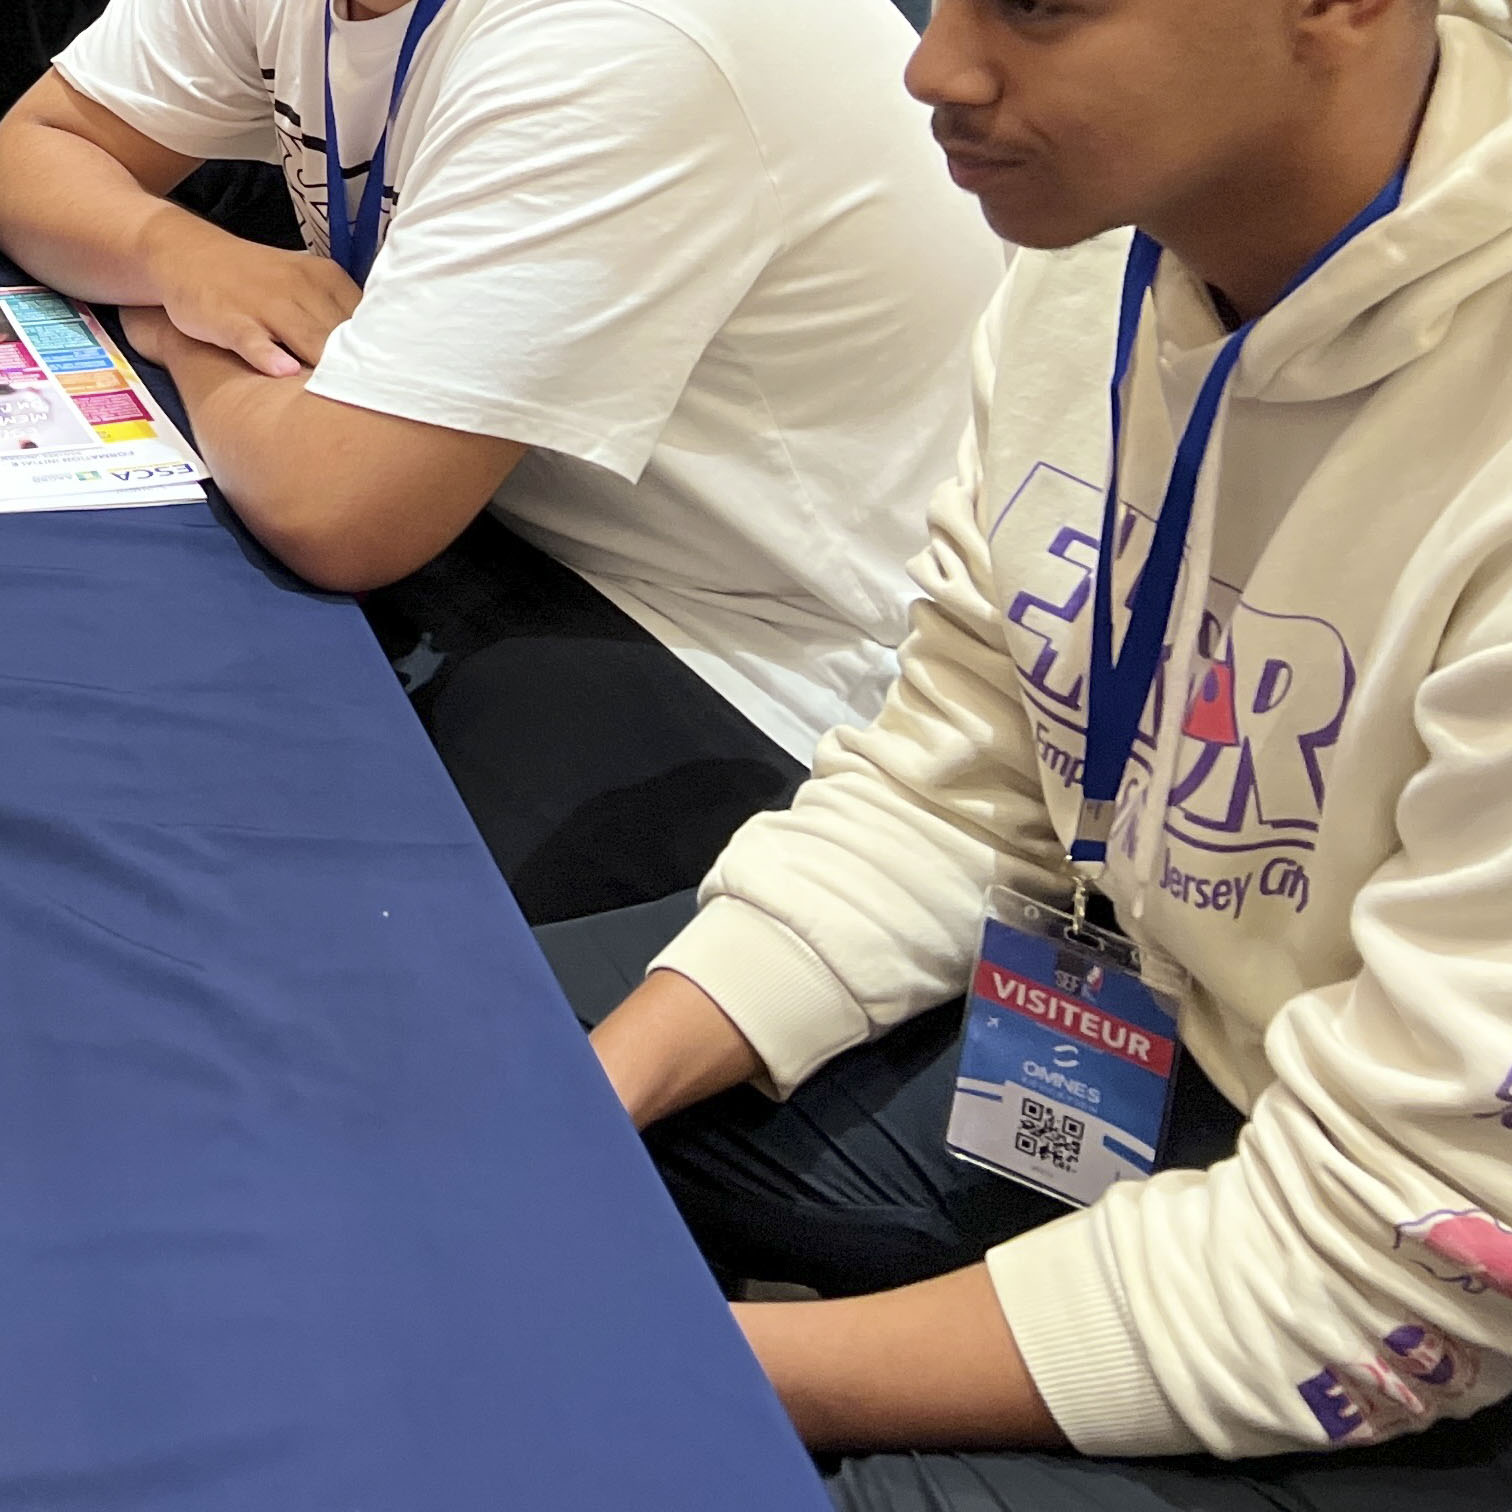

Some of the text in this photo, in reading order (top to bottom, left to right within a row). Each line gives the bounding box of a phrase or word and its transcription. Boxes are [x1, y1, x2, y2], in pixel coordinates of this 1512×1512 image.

[107, 463, 195, 486] ESCA
[1159, 847, 1254, 920] Jersey
[991, 971, 1152, 1062] VISITEUR
[1022, 1060, 1101, 1104] OMNES
